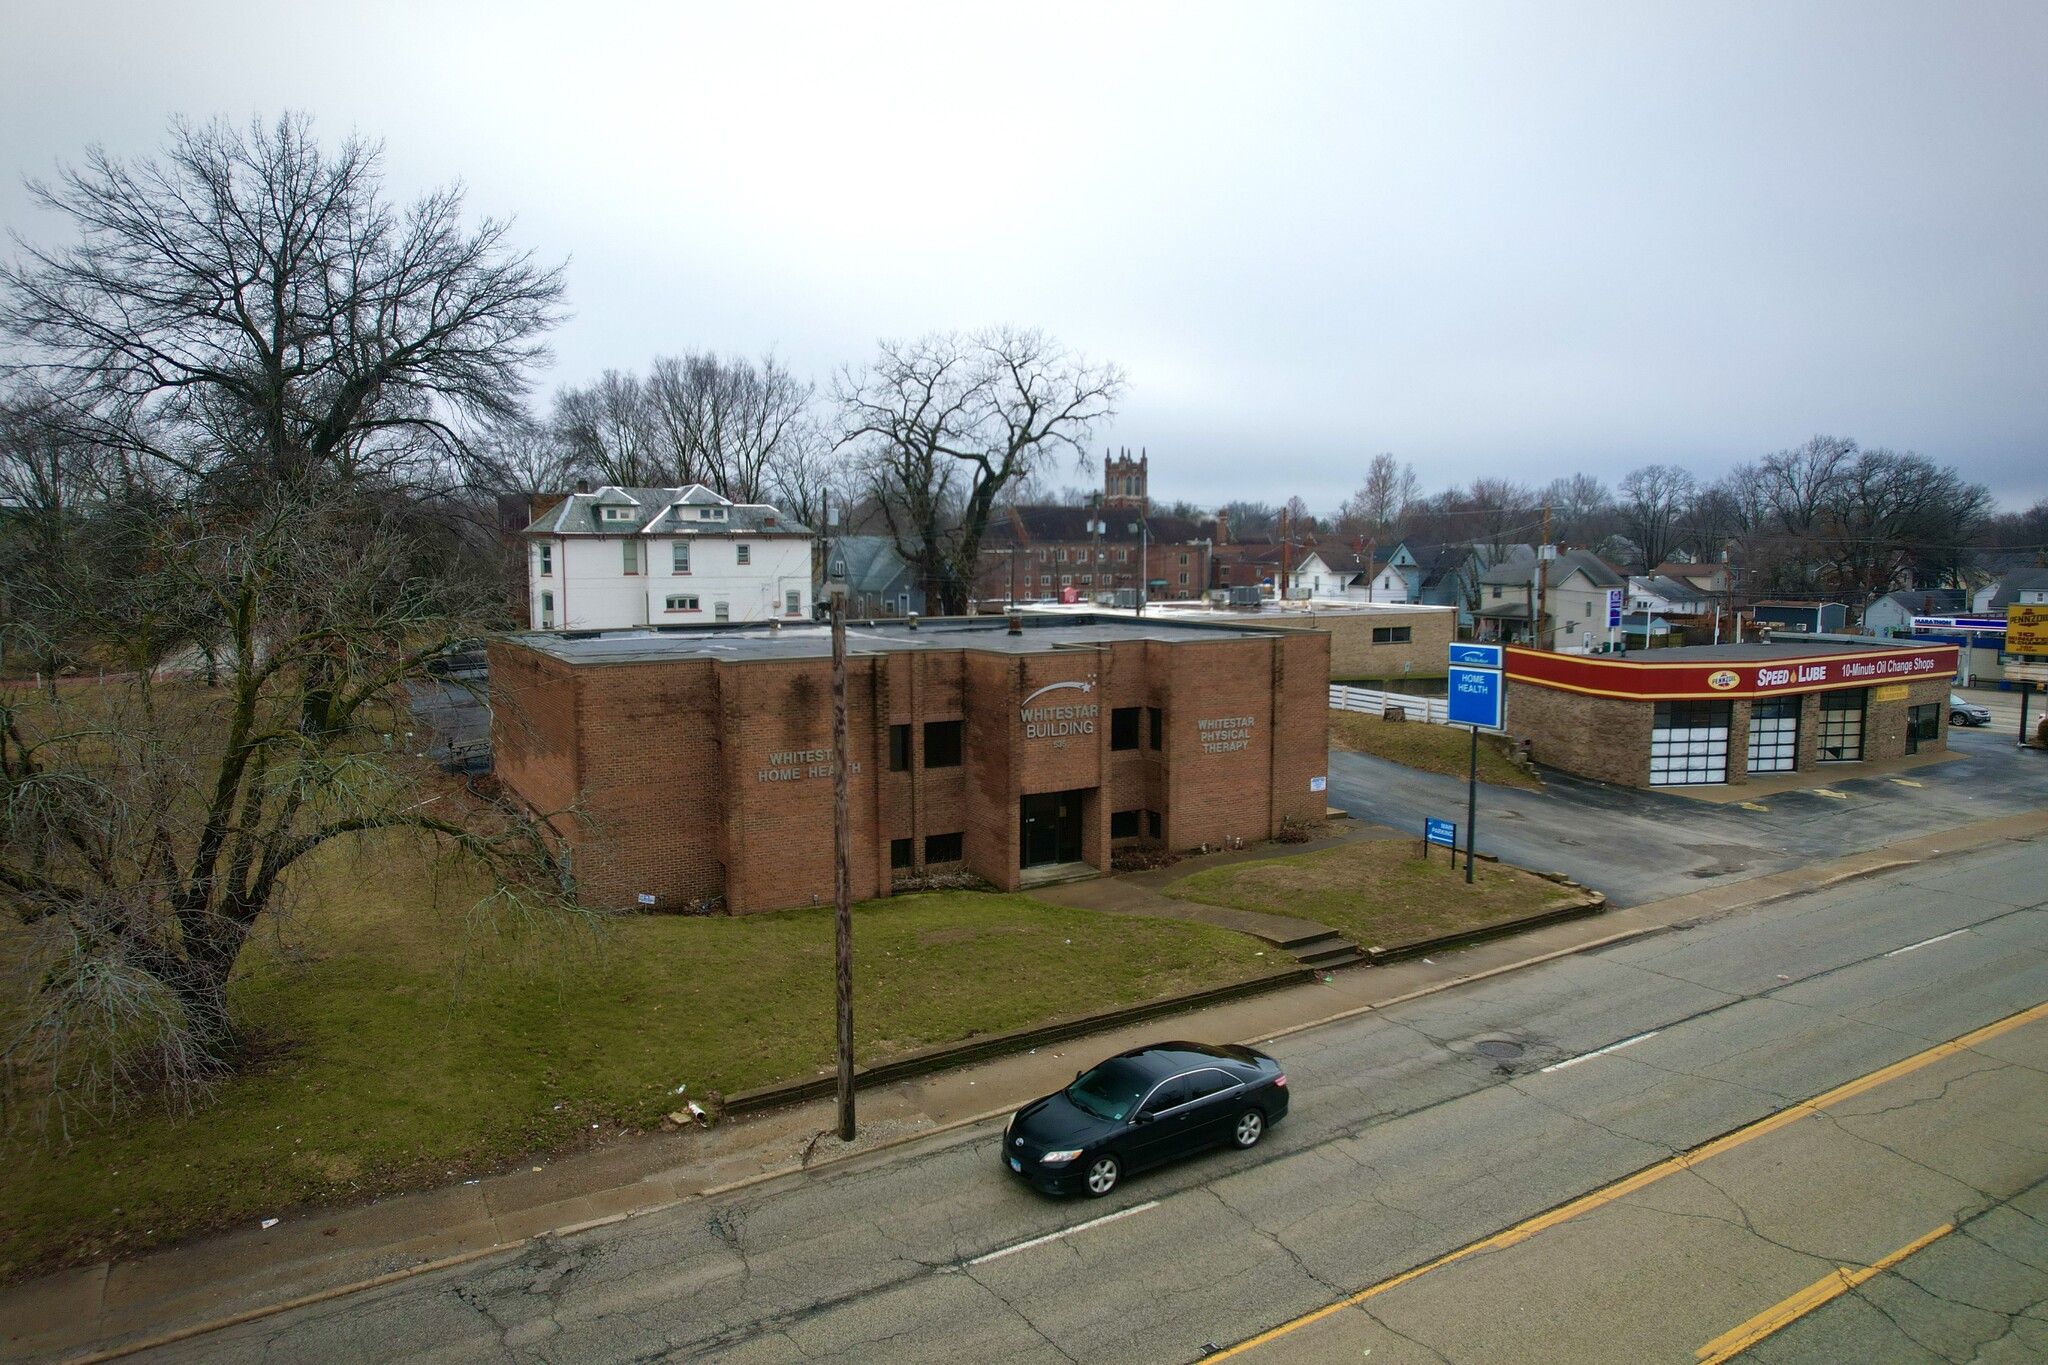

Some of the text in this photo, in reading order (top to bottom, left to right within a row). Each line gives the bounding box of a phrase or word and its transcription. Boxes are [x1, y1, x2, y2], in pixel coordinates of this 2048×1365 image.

[1842, 657, 1935, 677] 10-Minute Oil Change Shops
[1461, 673, 1485, 684] HOME
[1757, 665, 1827, 687] SPEED LUBE
[1458, 683, 1488, 694] HEALTH
[1020, 704, 1099, 722] WHITESTAR
[1026, 720, 1094, 738] BUILDING
[1198, 716, 1255, 730] WHITESTAR
[1201, 729, 1251, 742] PHYSICAL
[1203, 740, 1249, 754] THERAPY
[758, 767, 801, 782] HOME
